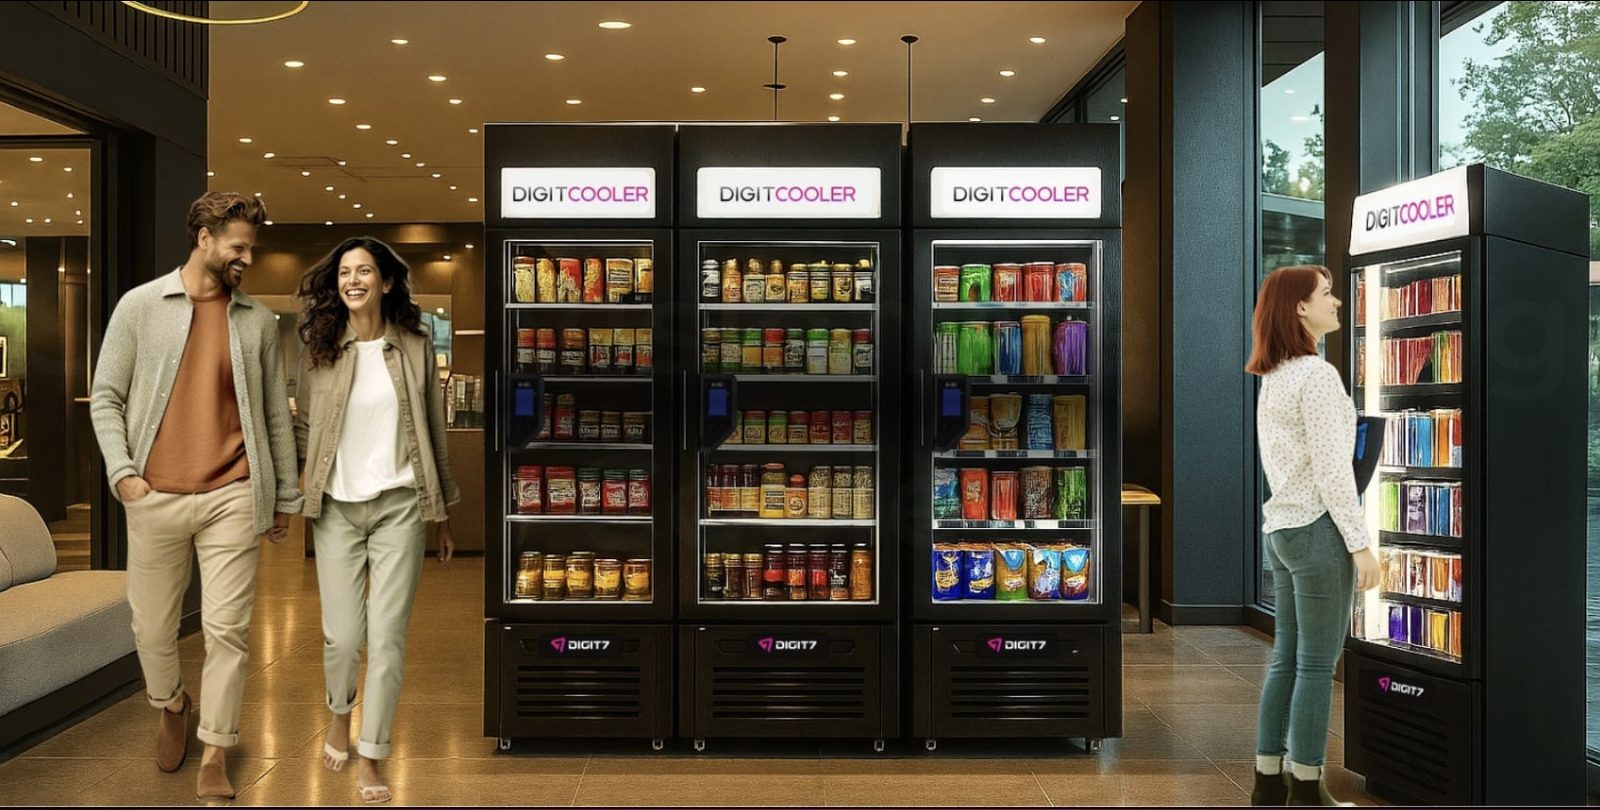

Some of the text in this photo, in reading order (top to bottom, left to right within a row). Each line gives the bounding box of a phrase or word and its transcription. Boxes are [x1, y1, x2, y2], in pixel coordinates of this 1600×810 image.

[512, 185, 649, 203] DIGITCOOLER
[719, 185, 856, 203] DIGITCOOLER
[952, 185, 1090, 203] DIGITCOOLER
[1365, 194, 1455, 231] DIGITCOOLER
[567, 640, 611, 652] DIGIT7
[775, 640, 818, 652] DIGIT7
[1004, 640, 1047, 652] DIGIT7
[1390, 681, 1425, 697] DIGIT7
